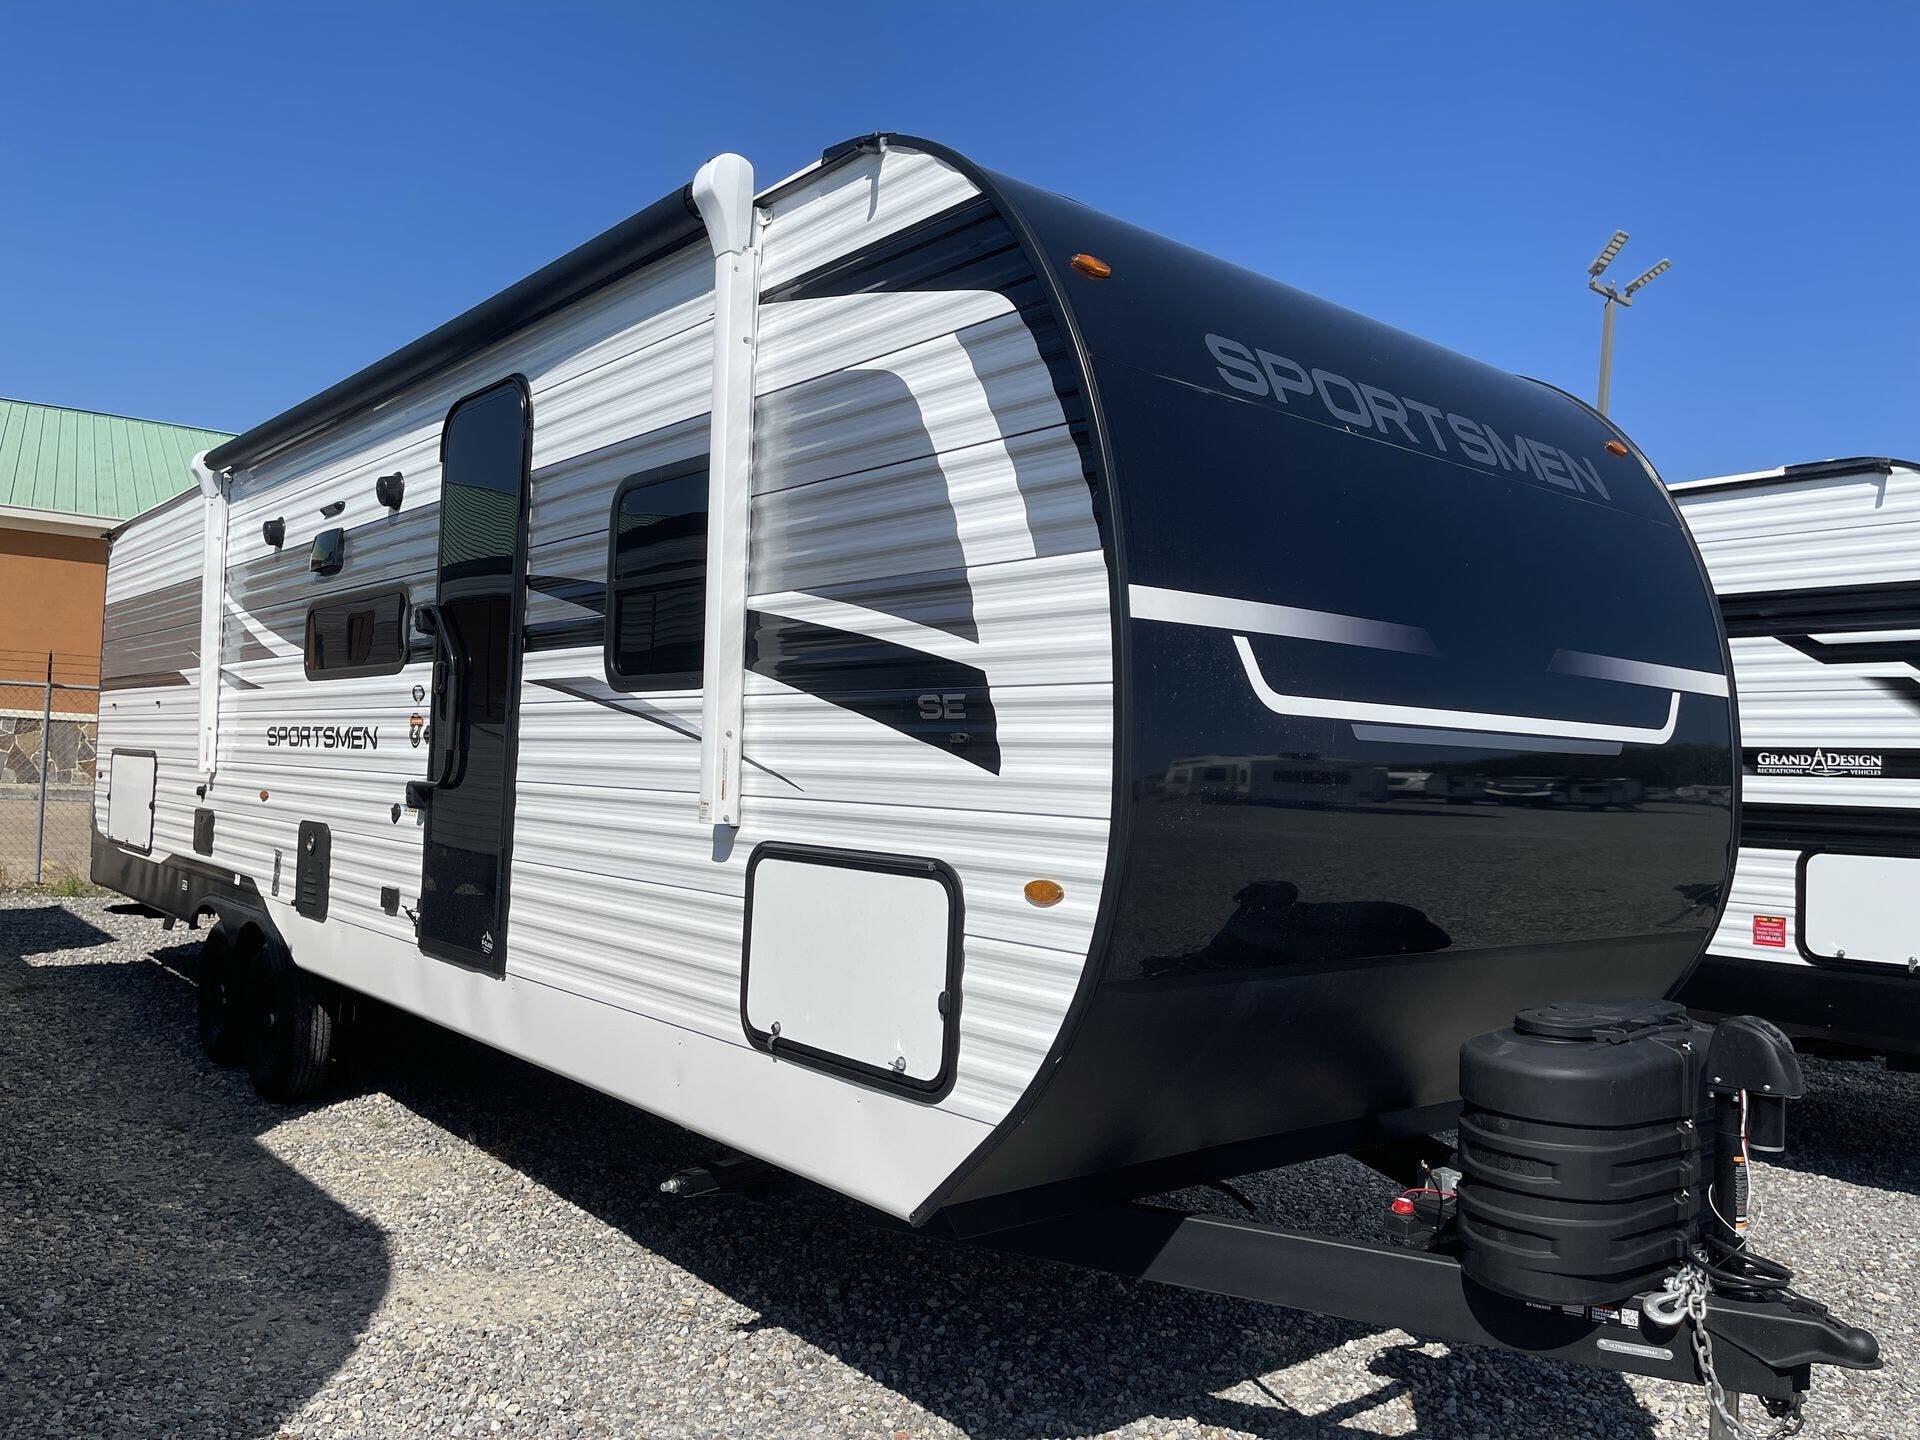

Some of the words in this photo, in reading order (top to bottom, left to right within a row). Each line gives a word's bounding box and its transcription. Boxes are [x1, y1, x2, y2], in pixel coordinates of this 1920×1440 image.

[1205, 333, 1612, 501] SPORTSMEN
[917, 693, 967, 719] SE
[268, 726, 379, 749] SPORTSMEN
